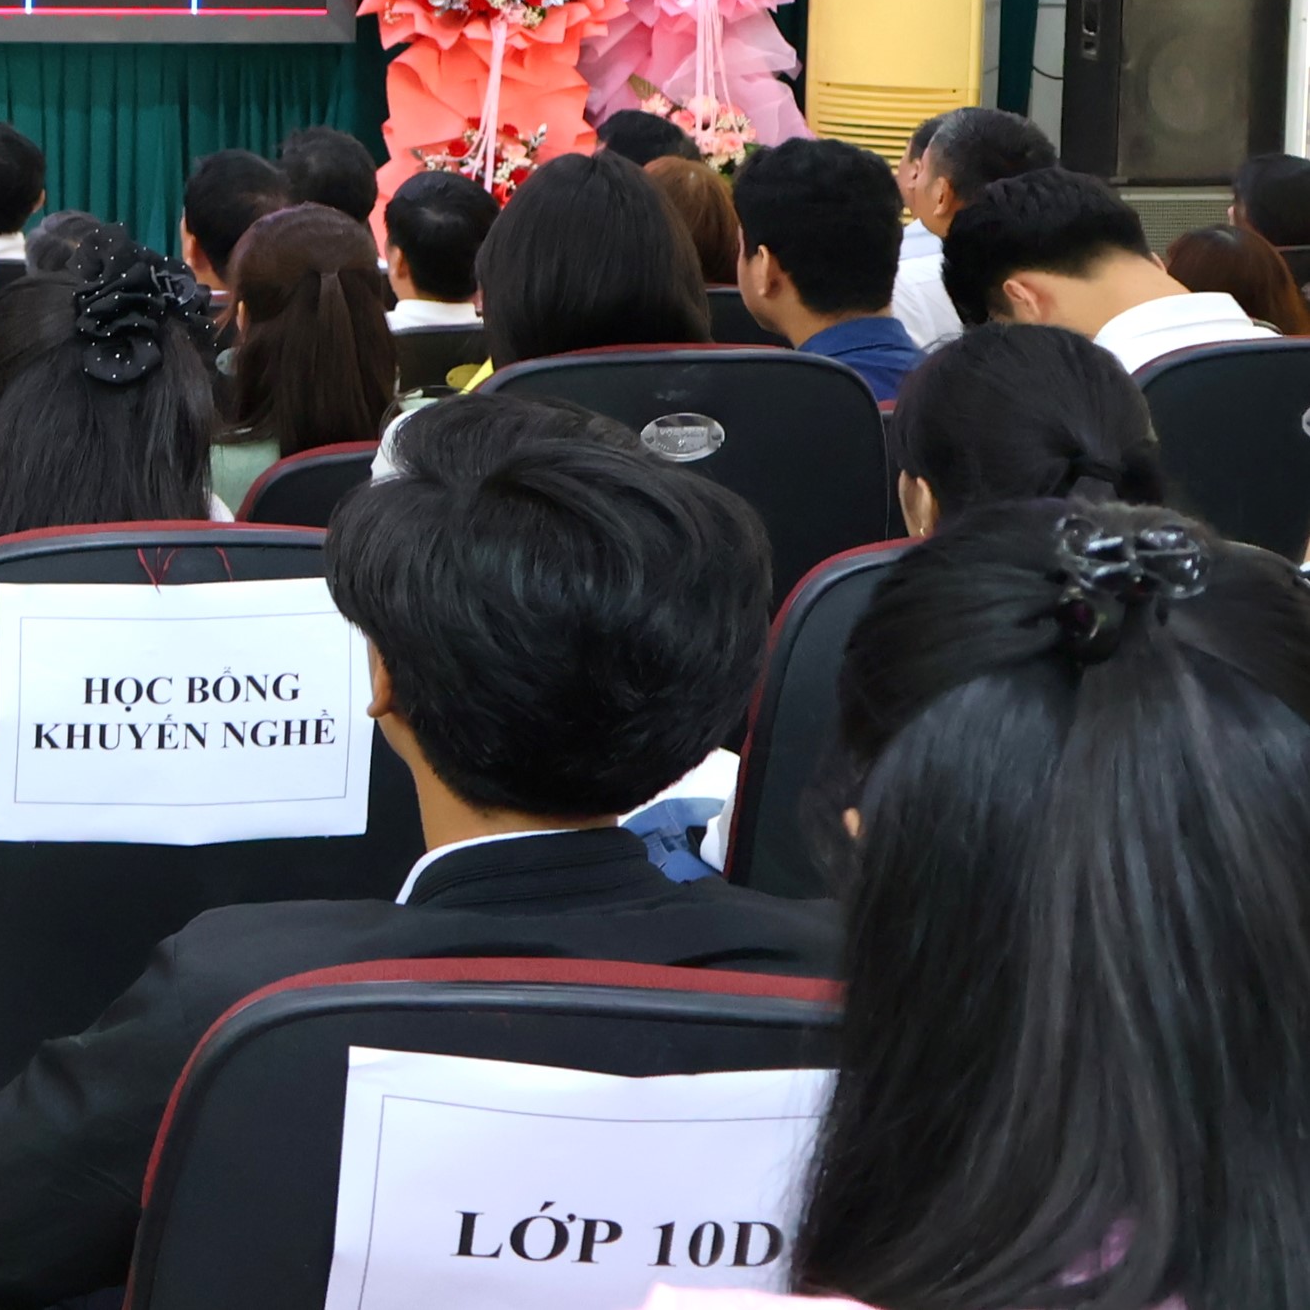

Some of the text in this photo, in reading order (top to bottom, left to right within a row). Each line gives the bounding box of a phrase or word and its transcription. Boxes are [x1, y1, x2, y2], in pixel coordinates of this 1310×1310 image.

[83, 677, 174, 713] HỌC
[32, 710, 336, 750] KHUYẾN NGHỀ
[450, 1200, 624, 1264] LỚP
